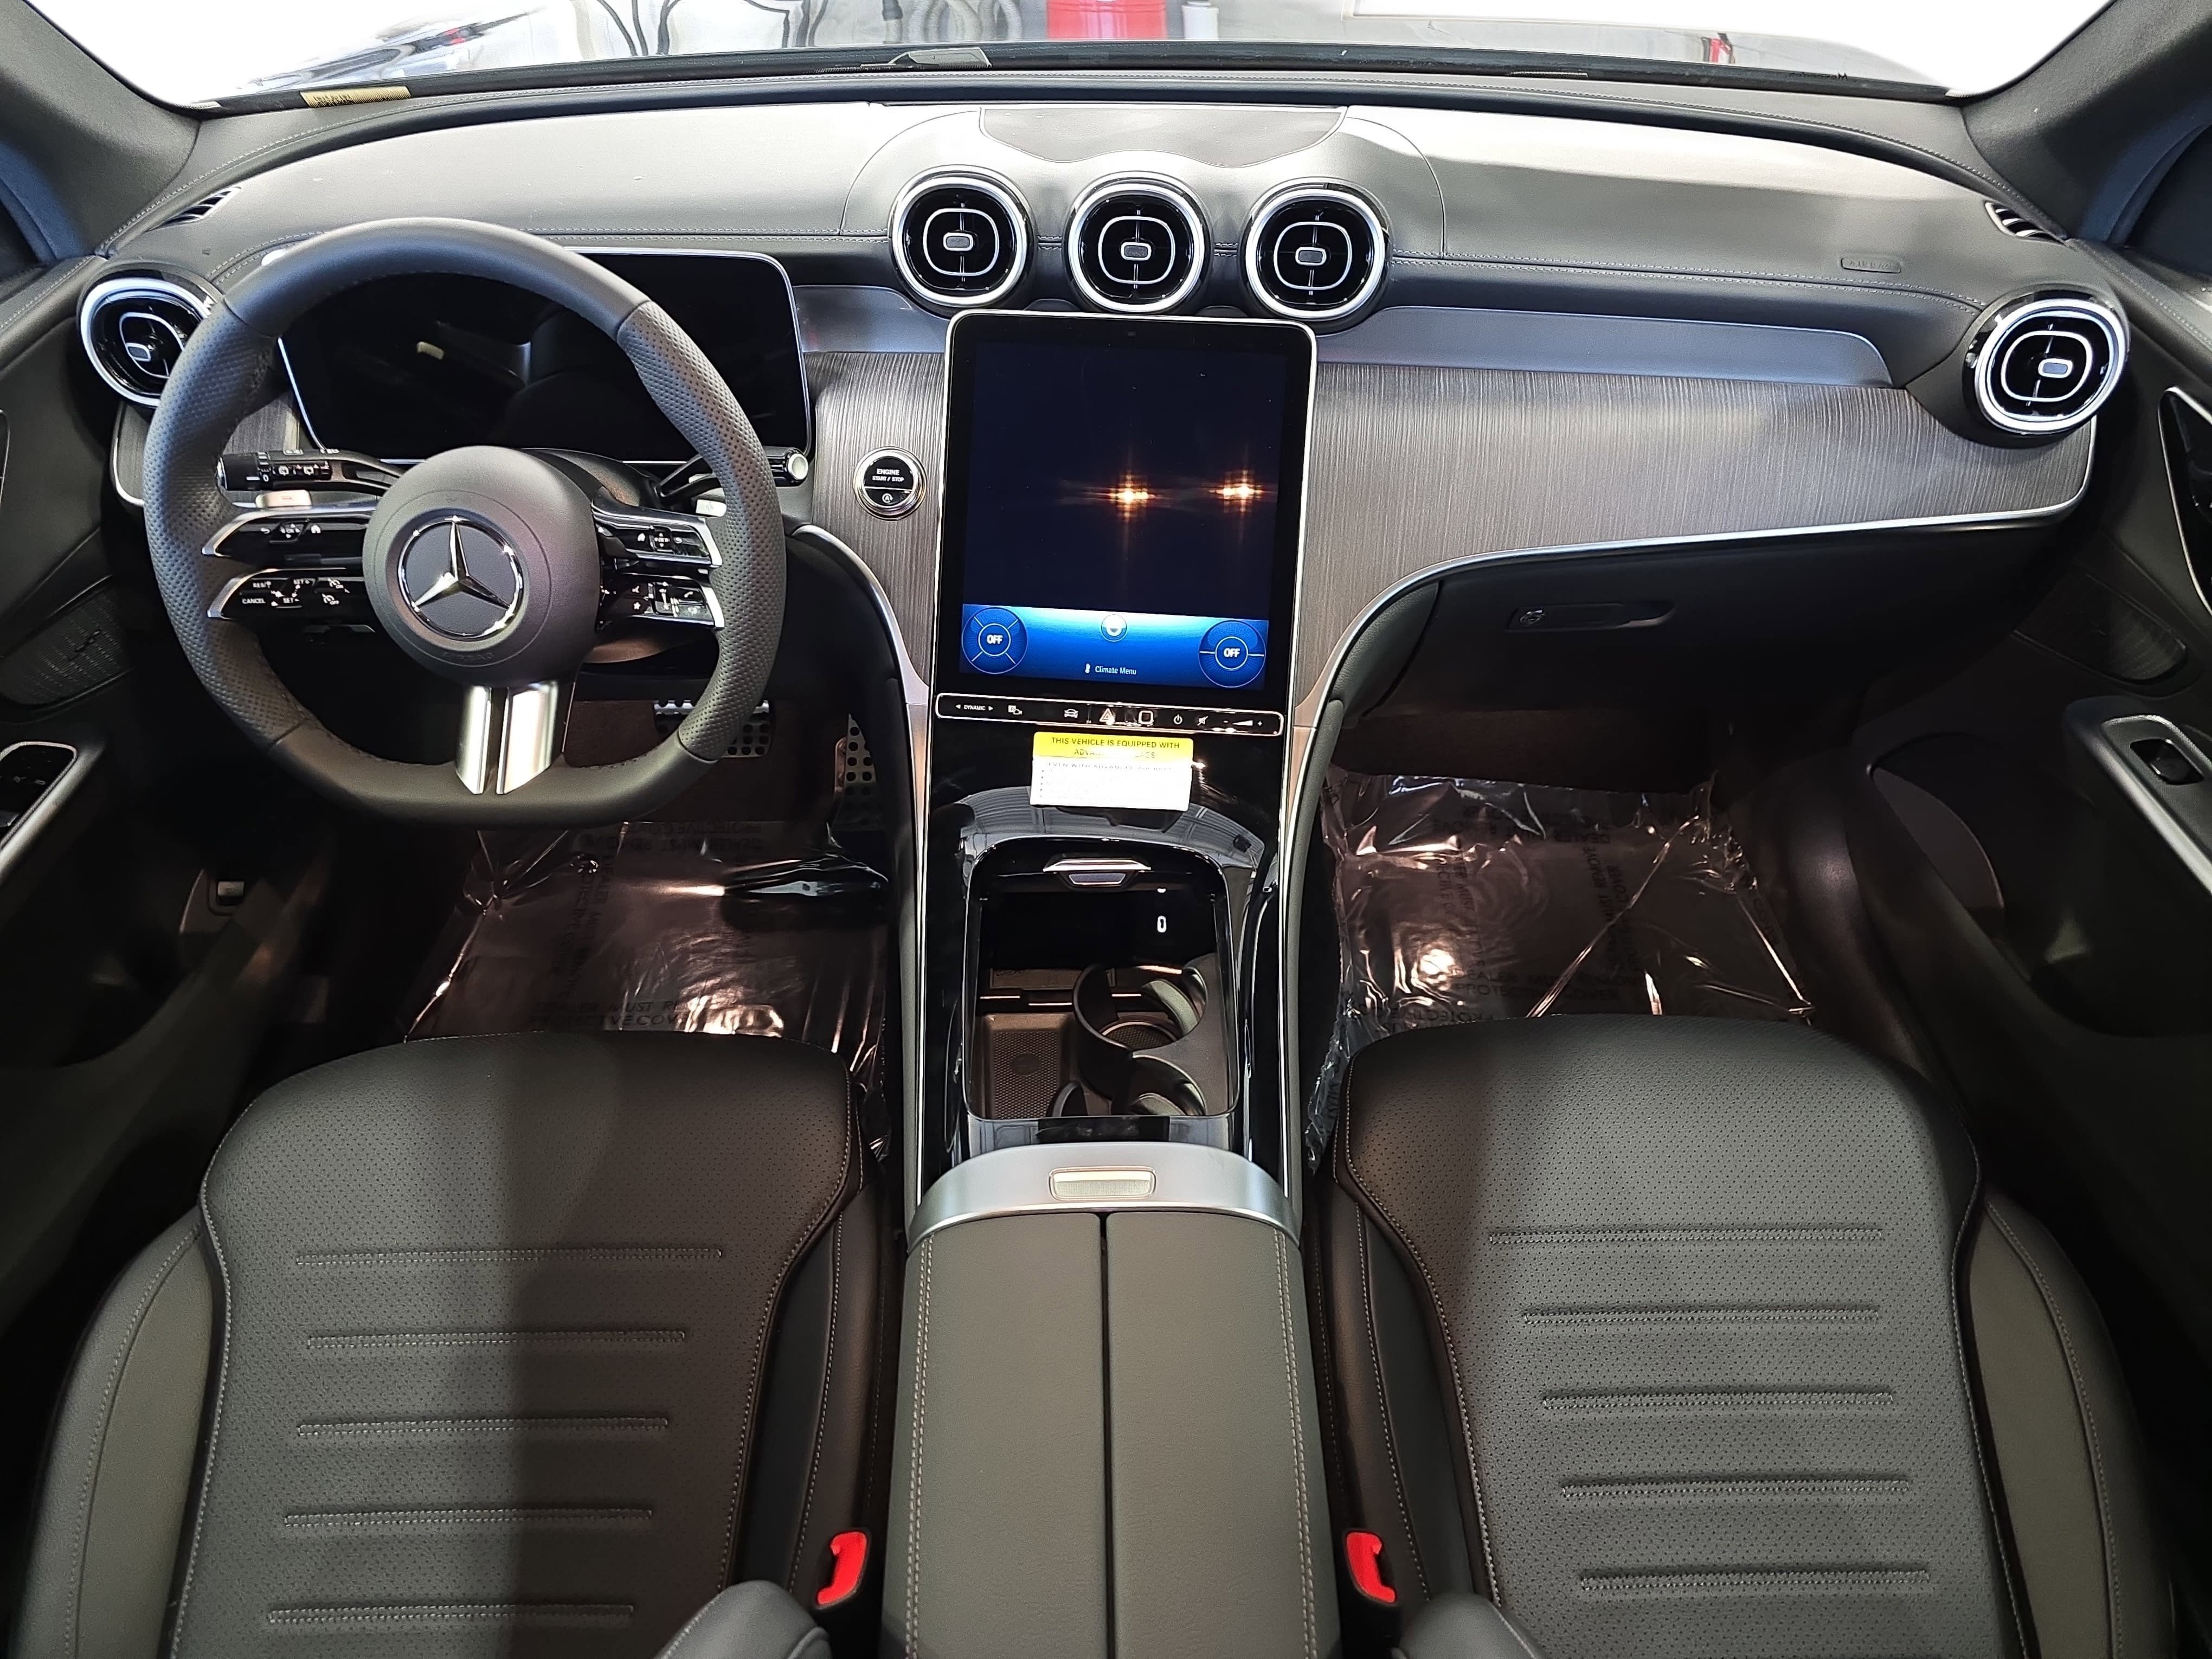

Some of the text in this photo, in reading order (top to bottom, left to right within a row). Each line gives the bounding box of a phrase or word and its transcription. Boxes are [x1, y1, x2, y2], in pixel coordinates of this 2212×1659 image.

[986, 634, 1003, 645] OFF
[1223, 647, 1240, 658] OFF
[1095, 665, 1137, 676] Climate Menu
[1072, 738, 1104, 746] VEHICLE
[1117, 740, 1157, 748] EQUIPPED
[1583, 846, 1607, 889] REMOVE
